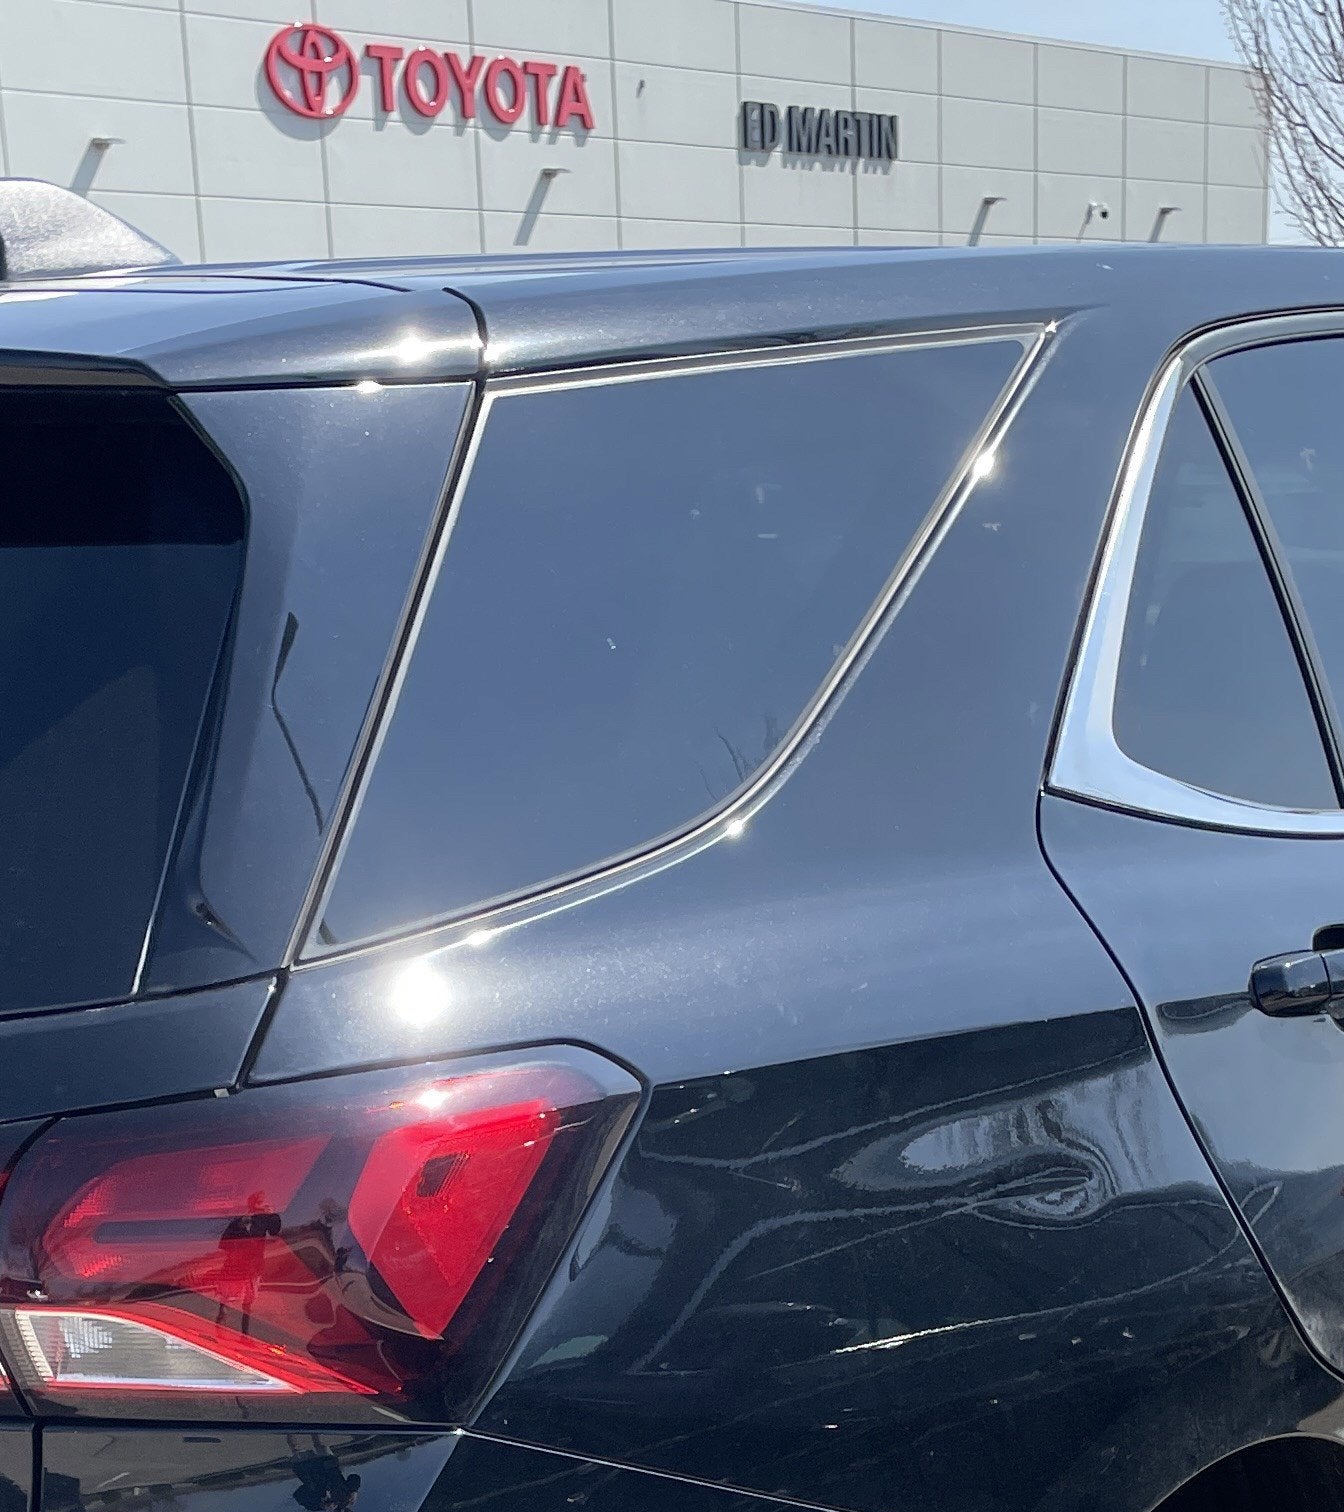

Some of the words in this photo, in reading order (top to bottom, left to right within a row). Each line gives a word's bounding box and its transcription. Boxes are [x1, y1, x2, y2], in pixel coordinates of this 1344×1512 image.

[365, 44, 595, 129] TOYOTA
[742, 101, 781, 150] ED
[786, 105, 898, 161] MARTIN
